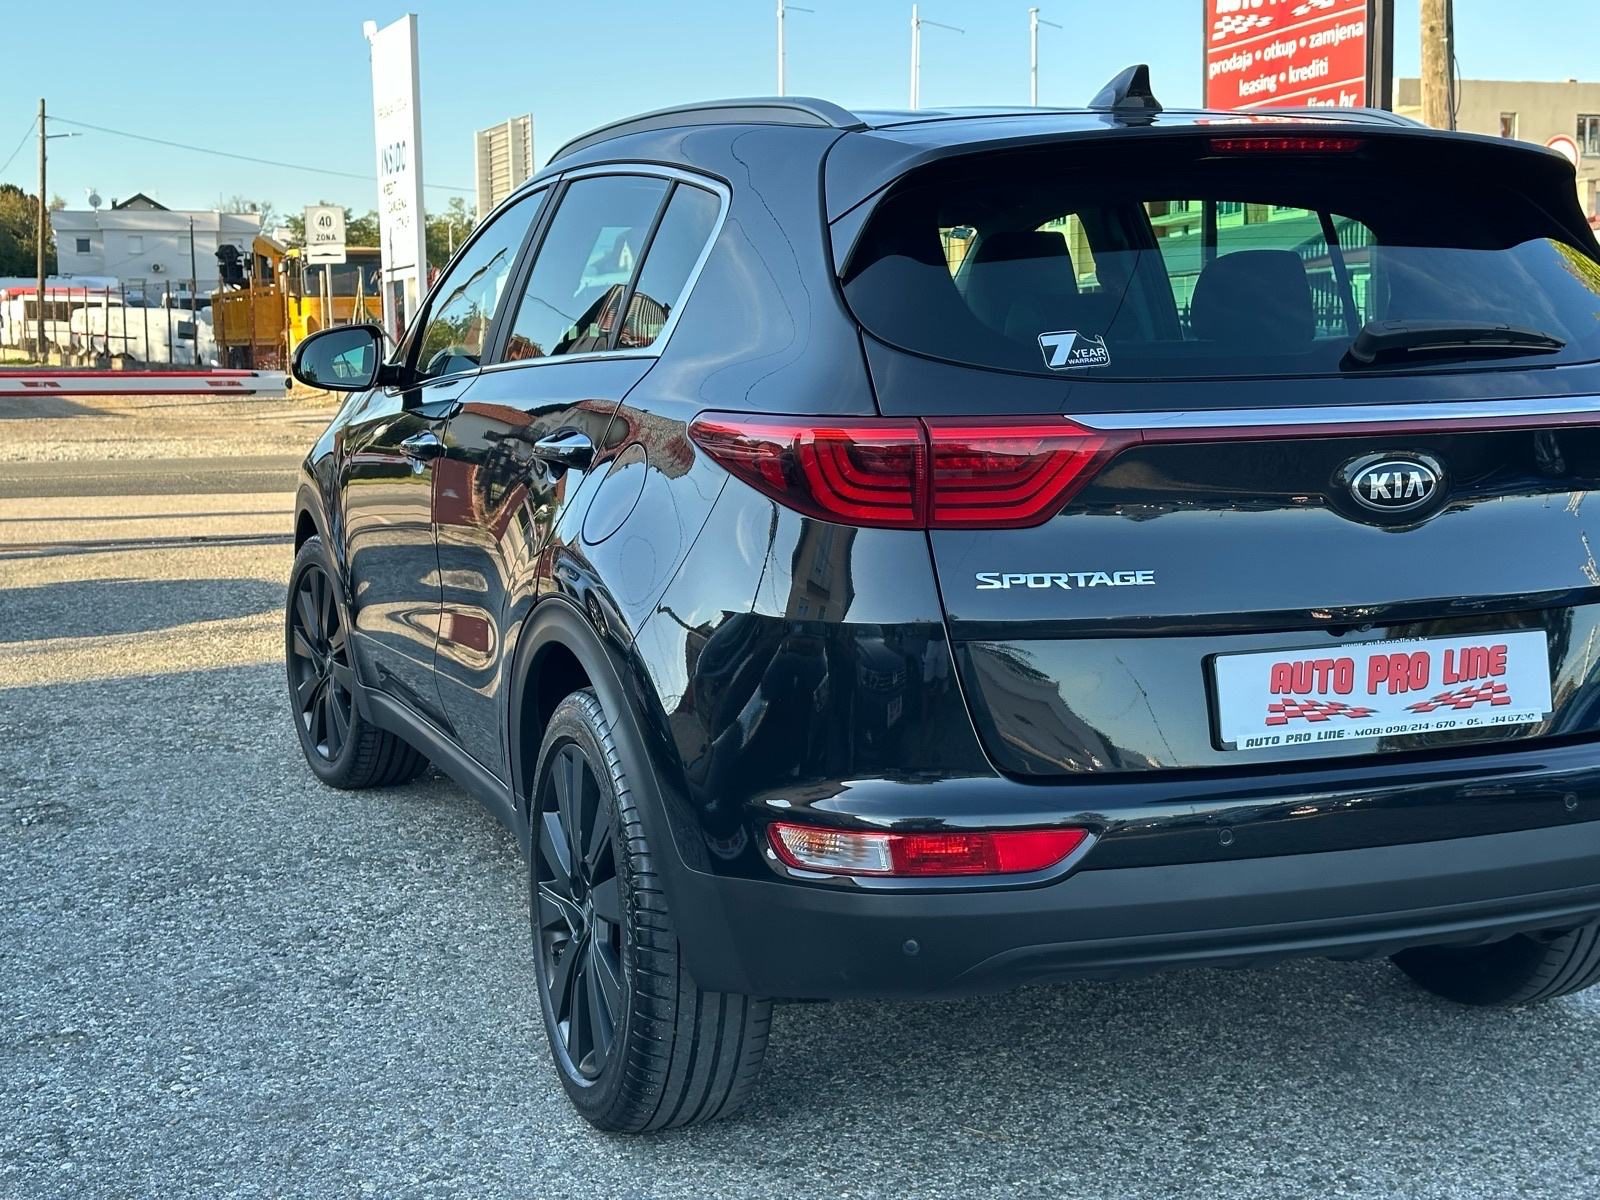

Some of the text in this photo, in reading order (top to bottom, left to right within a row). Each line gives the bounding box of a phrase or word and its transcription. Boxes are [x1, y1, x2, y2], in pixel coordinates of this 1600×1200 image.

[1209, 21, 1364, 79] prodaja otkup zamjena
[1239, 56, 1329, 96] leasing krediti
[319, 216, 332, 227] 40
[1041, 333, 1106, 366] 7 YEAR
[1068, 356, 1107, 365] WARRANTY
[1368, 471, 1424, 499] KIA
[975, 570, 1156, 590] SPORTAGE
[1270, 644, 1508, 695] AUTO PRO LINE
[1246, 735, 1280, 747] AUTO
[1286, 732, 1311, 743] PRO
[1317, 729, 1345, 740] LINE
[1354, 725, 1383, 737] MOB:
